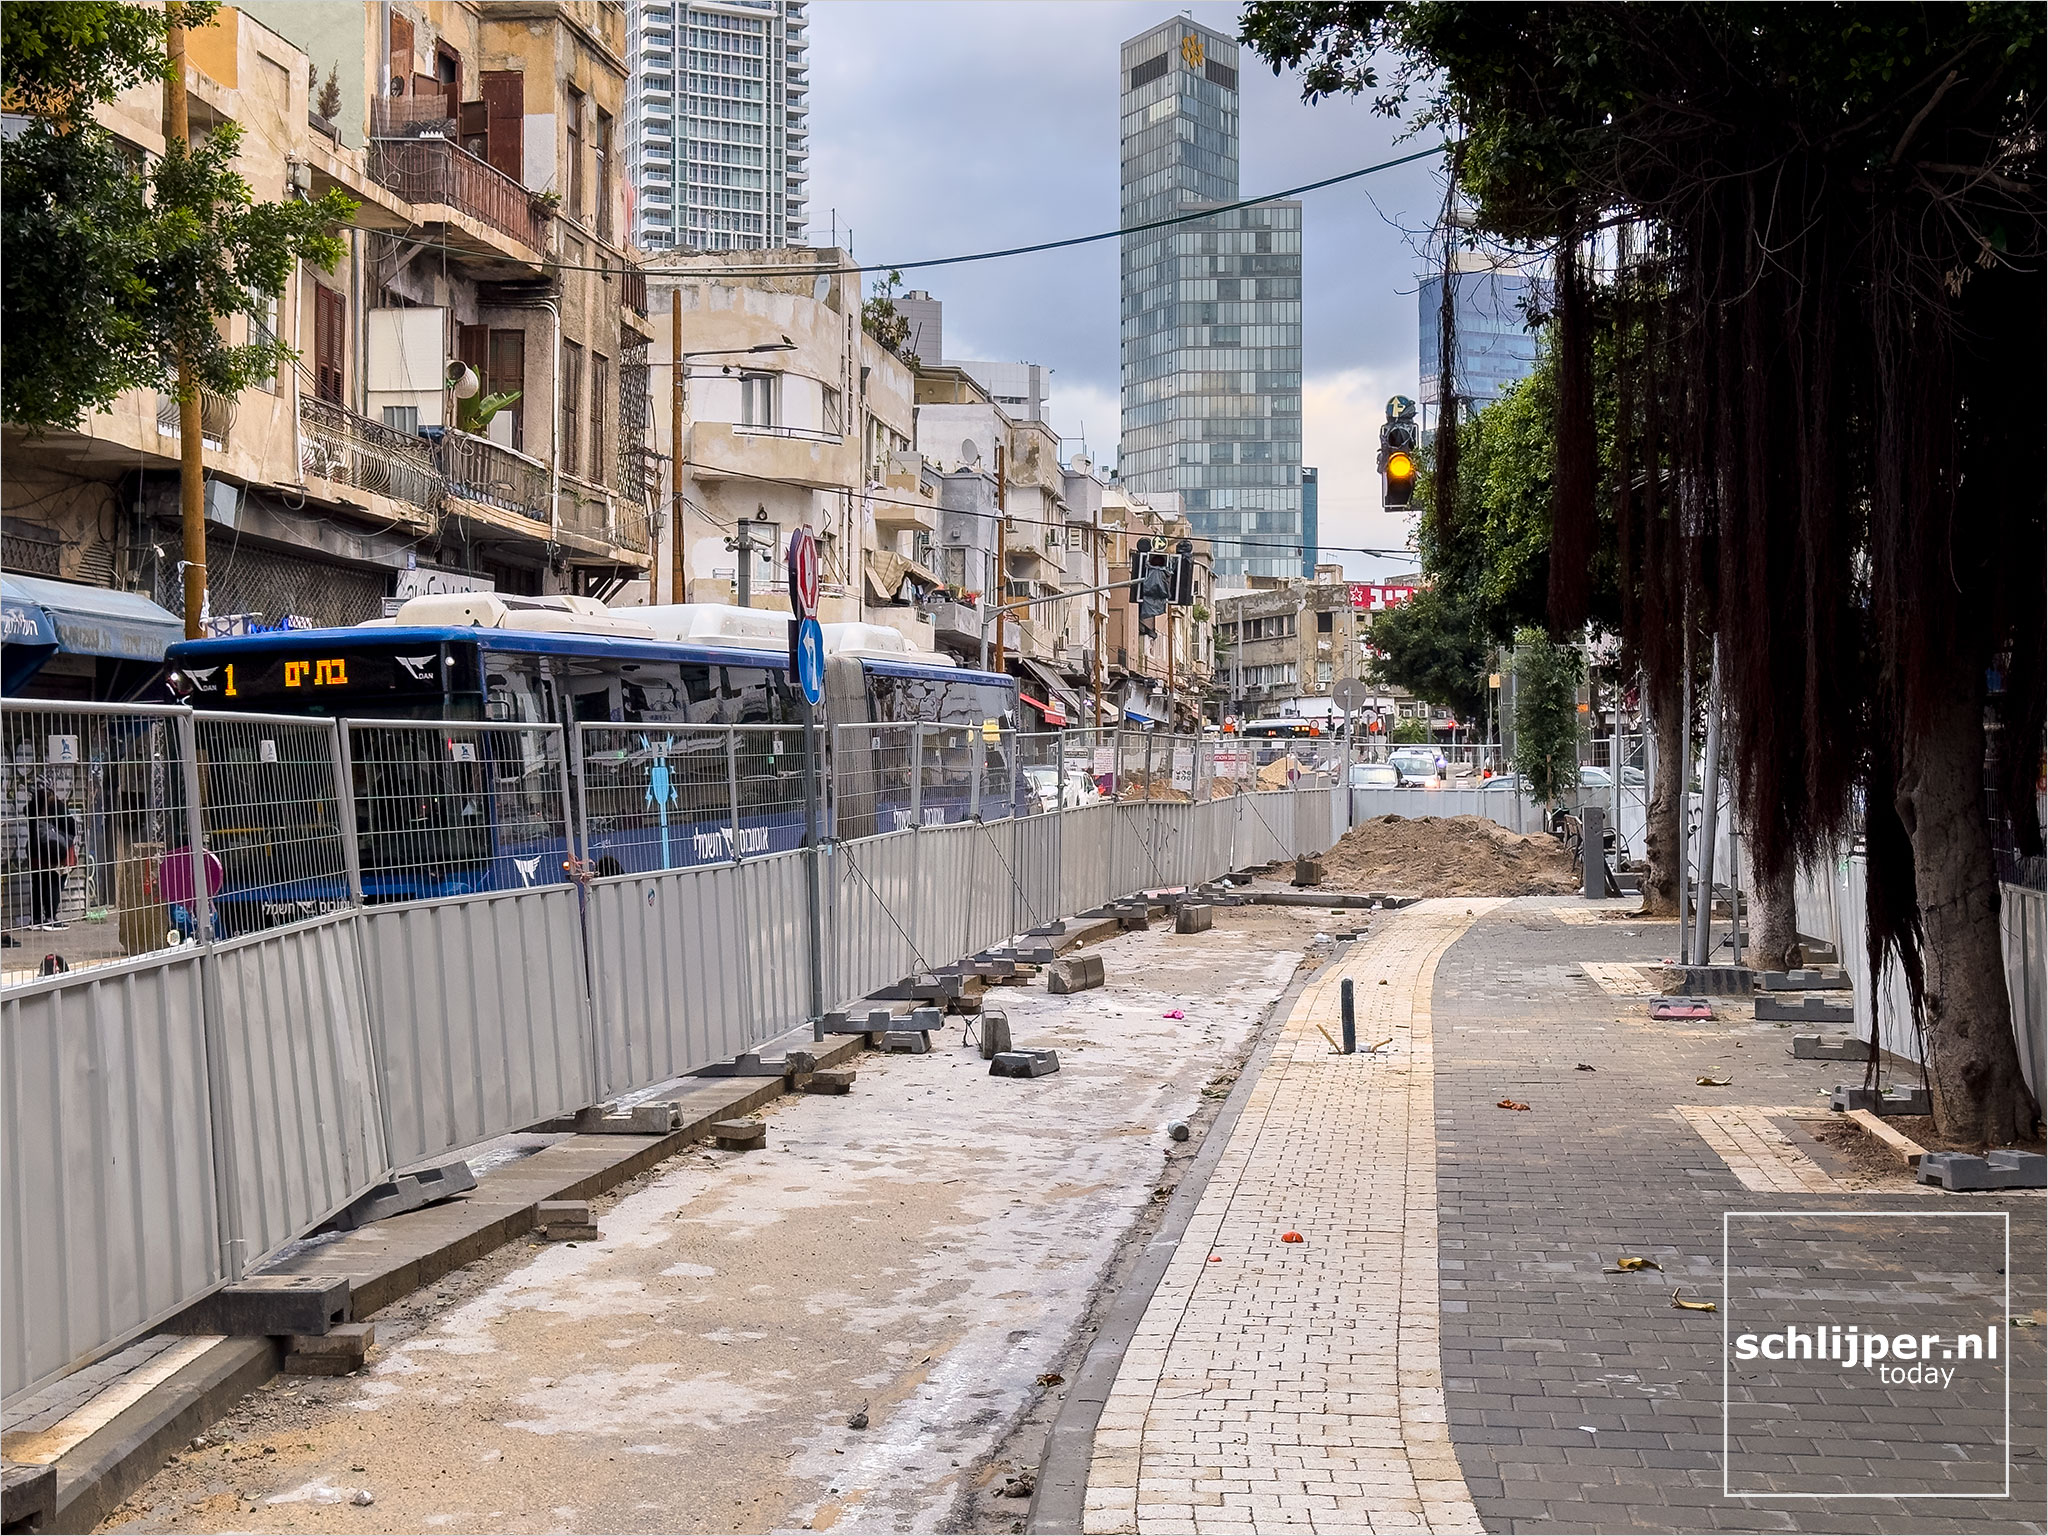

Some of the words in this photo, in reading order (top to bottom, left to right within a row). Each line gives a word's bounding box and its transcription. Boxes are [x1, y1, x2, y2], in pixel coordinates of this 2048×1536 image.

[224, 663, 237, 696] 1
[284, 660, 310, 687] ים
[314, 658, 349, 685] בת
[418, 672, 434, 680] DAN
[693, 826, 723, 860] חשמלי
[739, 826, 769, 854] אוטובוס
[262, 902, 296, 916] חשמלי
